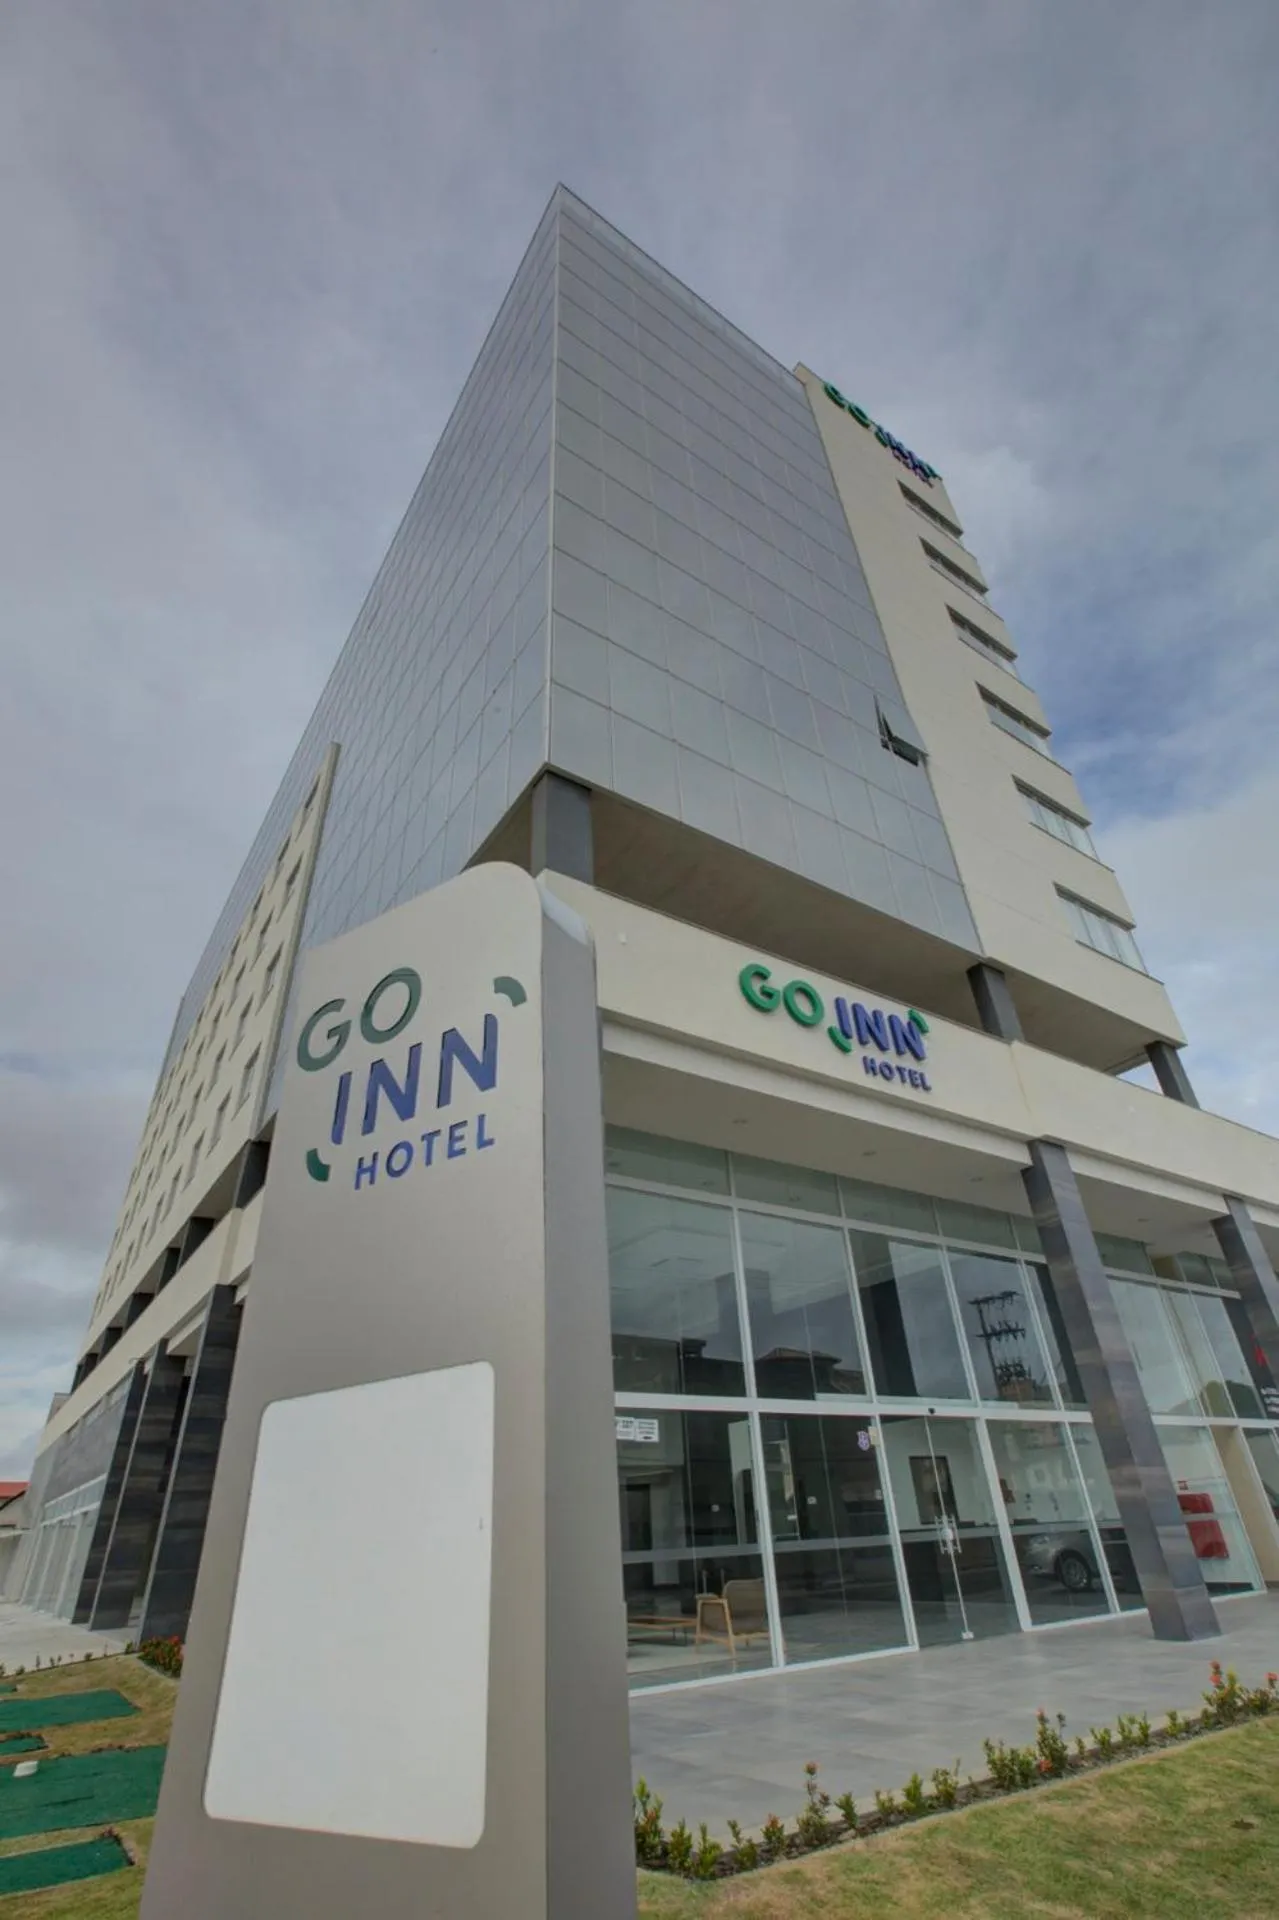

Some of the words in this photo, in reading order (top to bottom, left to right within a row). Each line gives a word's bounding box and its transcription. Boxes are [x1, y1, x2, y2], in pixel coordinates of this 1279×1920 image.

[297, 967, 422, 1072] GO
[738, 963, 824, 1027] GO
[834, 996, 926, 1061] INN
[331, 1012, 499, 1146] INN
[862, 1055, 932, 1091] HOTEL
[354, 1113, 495, 1191] HOTEL
